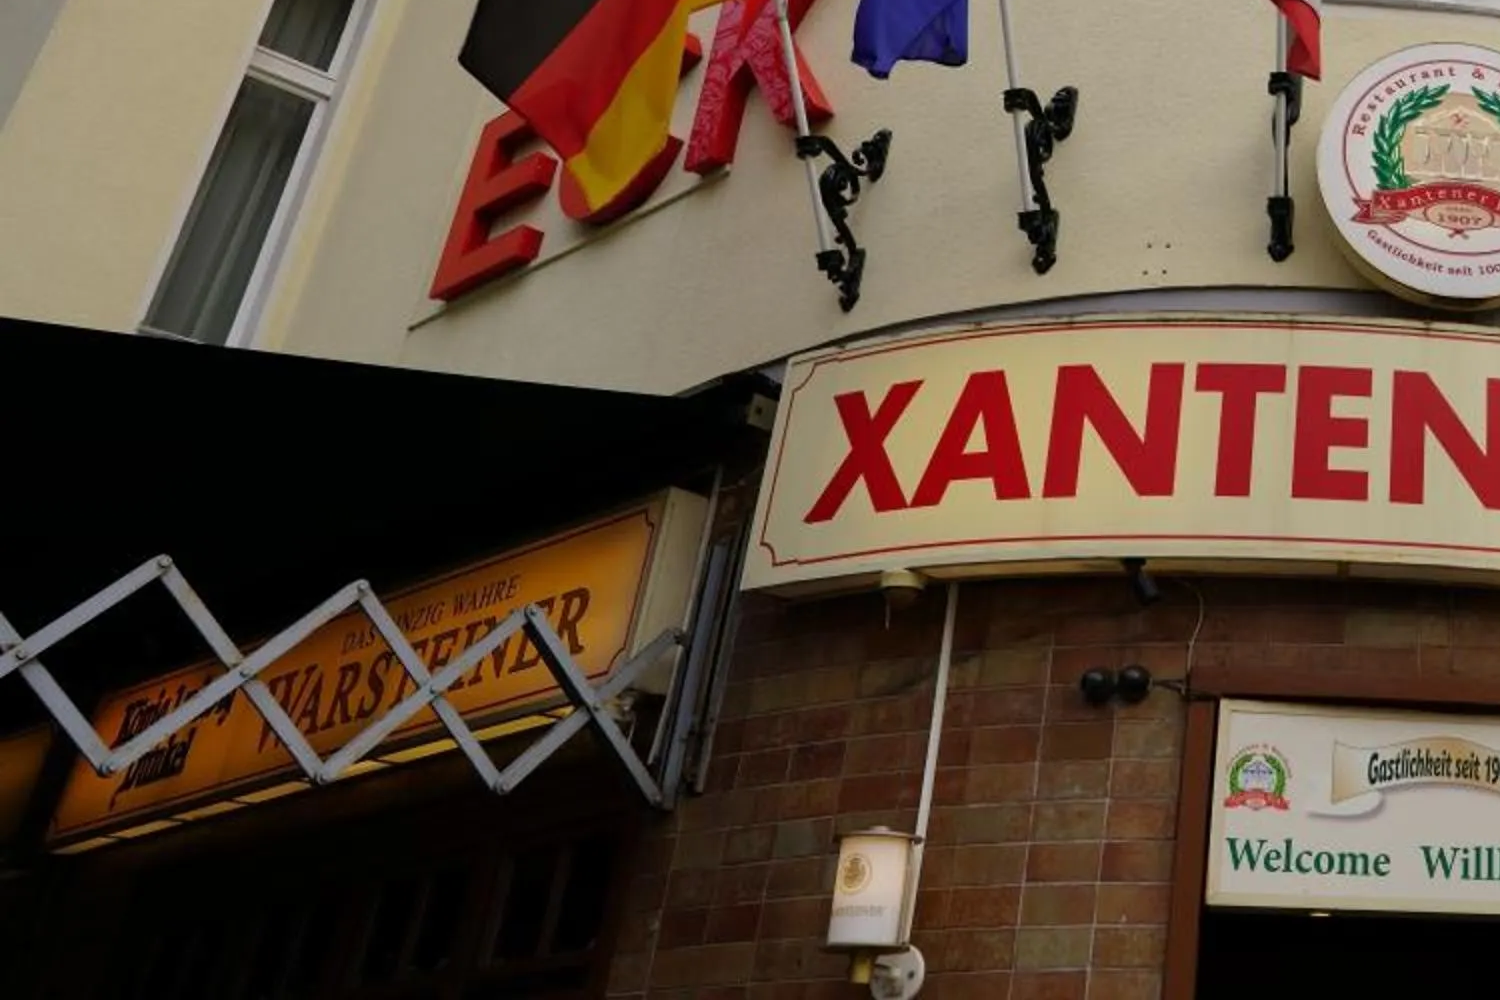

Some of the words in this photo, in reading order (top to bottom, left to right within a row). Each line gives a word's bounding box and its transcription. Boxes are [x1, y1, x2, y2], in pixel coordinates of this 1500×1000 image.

[1352, 66, 1457, 137] Restaurant
[1471, 67, 1486, 81] &
[1379, 188, 1488, 210] Xantener
[1437, 211, 1483, 226] 1907
[1367, 229, 1444, 274] Gastlichkeit
[1447, 265, 1473, 277] seit
[340, 627, 377, 655] DAS
[385, 601, 446, 635] INZIG
[452, 574, 522, 617] WAHRE
[1367, 747, 1453, 785] Gastlichkeit
[1455, 752, 1482, 781] seit
[1225, 837, 1391, 877] Welcome
